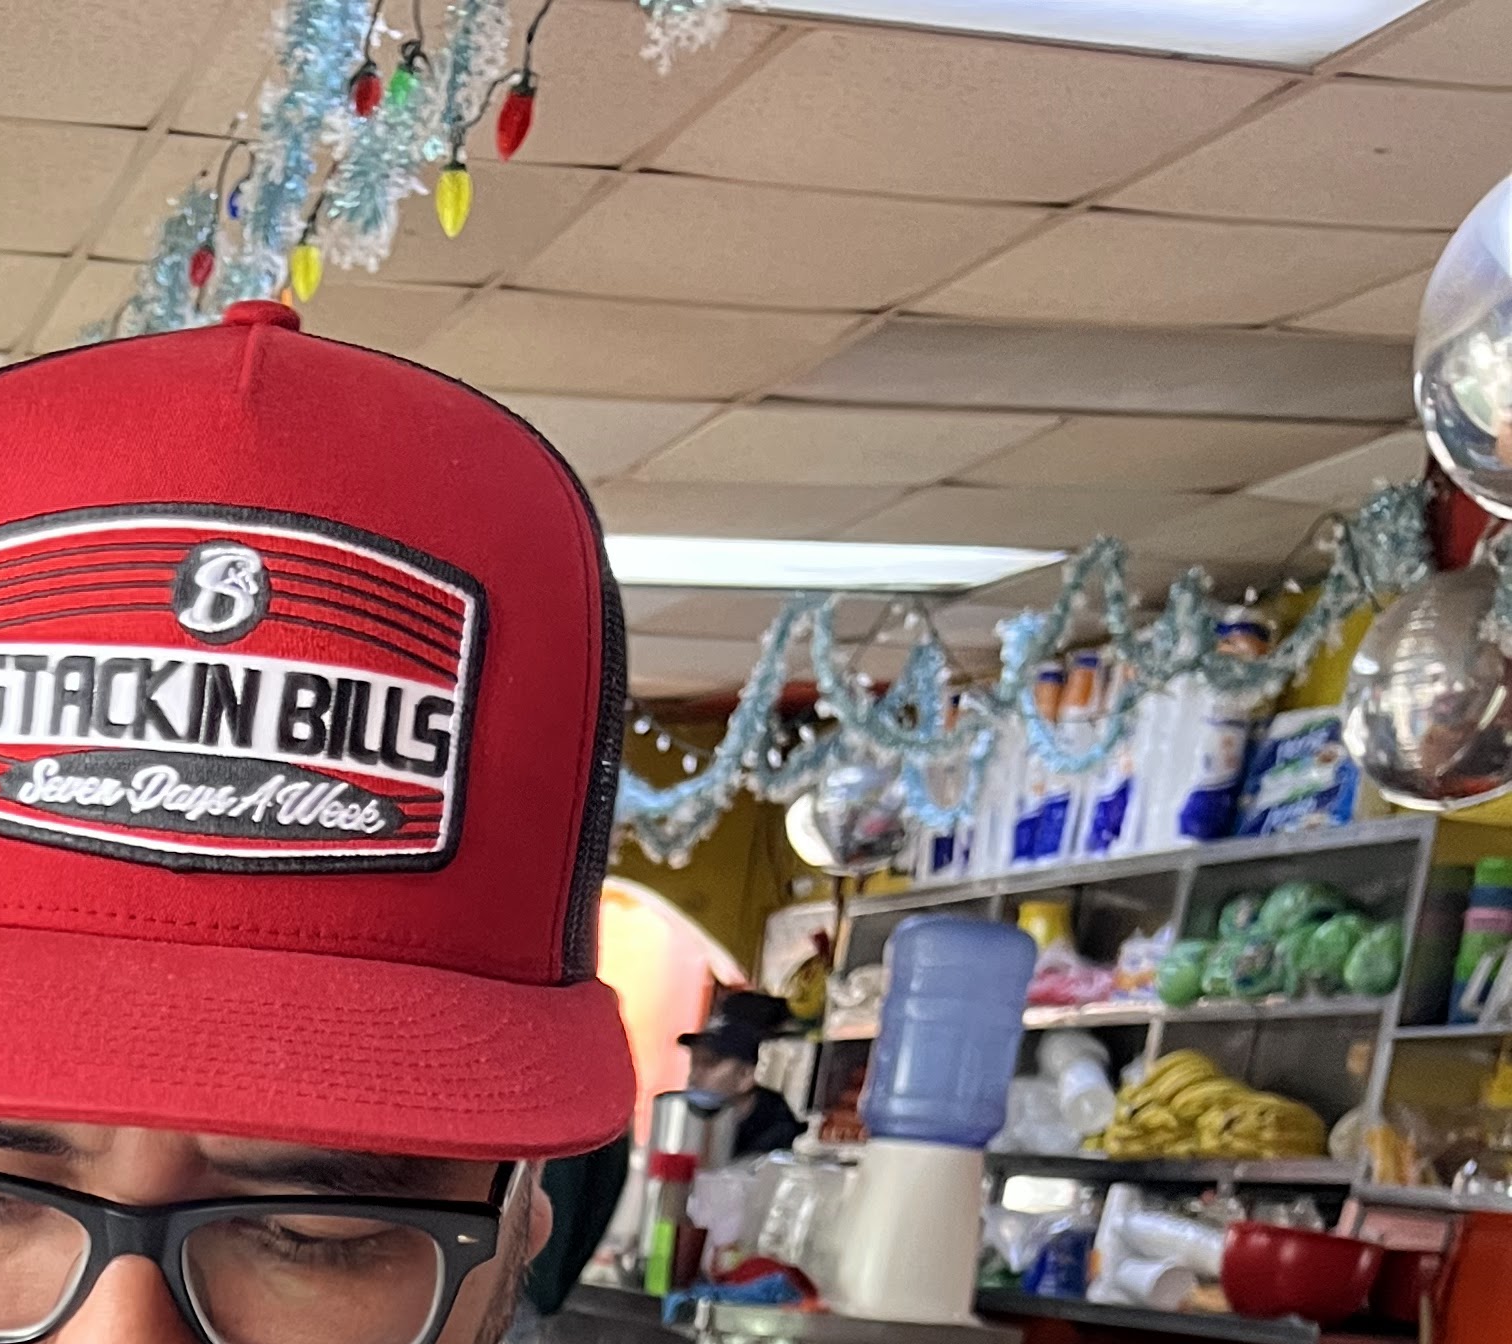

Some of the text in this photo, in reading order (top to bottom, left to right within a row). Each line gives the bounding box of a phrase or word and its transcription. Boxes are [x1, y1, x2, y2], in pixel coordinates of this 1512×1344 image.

[276, 671, 455, 777] BILLS
[17, 757, 387, 835] Seven Days A Week
